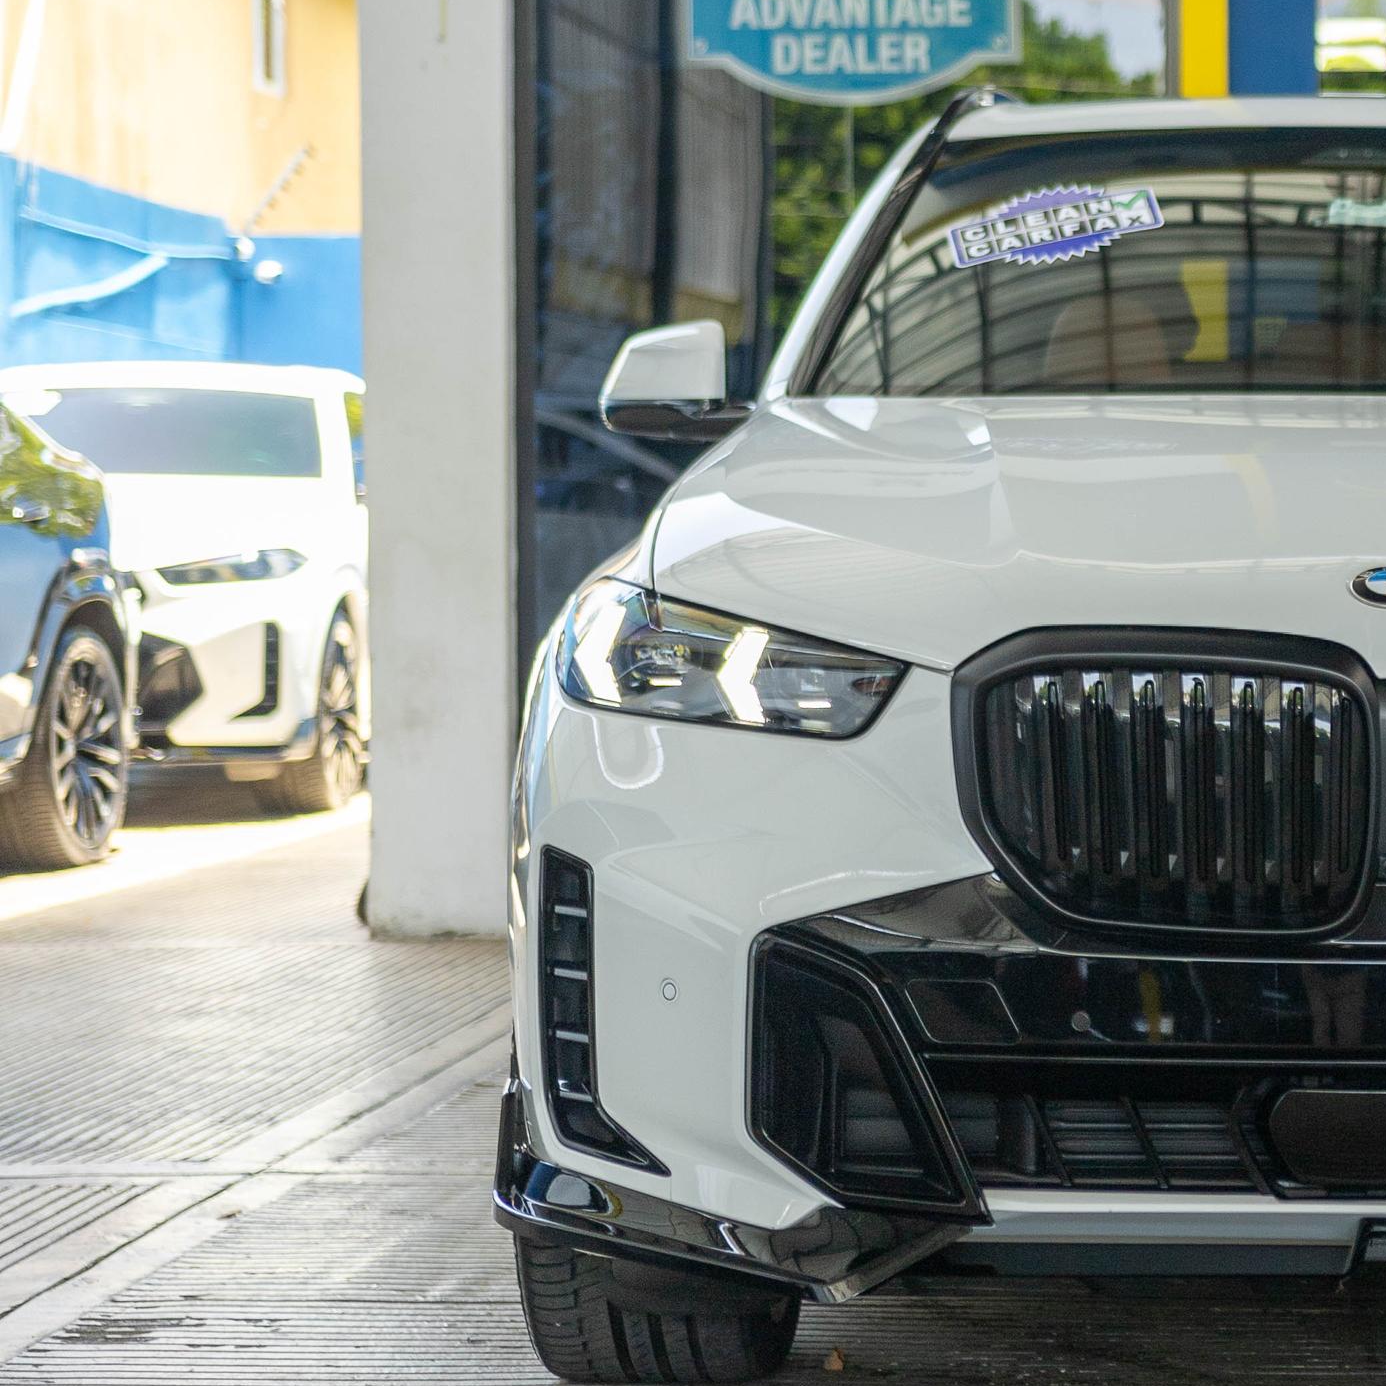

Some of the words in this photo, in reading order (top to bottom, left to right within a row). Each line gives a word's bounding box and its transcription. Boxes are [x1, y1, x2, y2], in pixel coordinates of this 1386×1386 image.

[772, 33, 931, 76] DEALER
[963, 198, 1112, 243] CLEAN
[967, 214, 1144, 258] CARFAX
